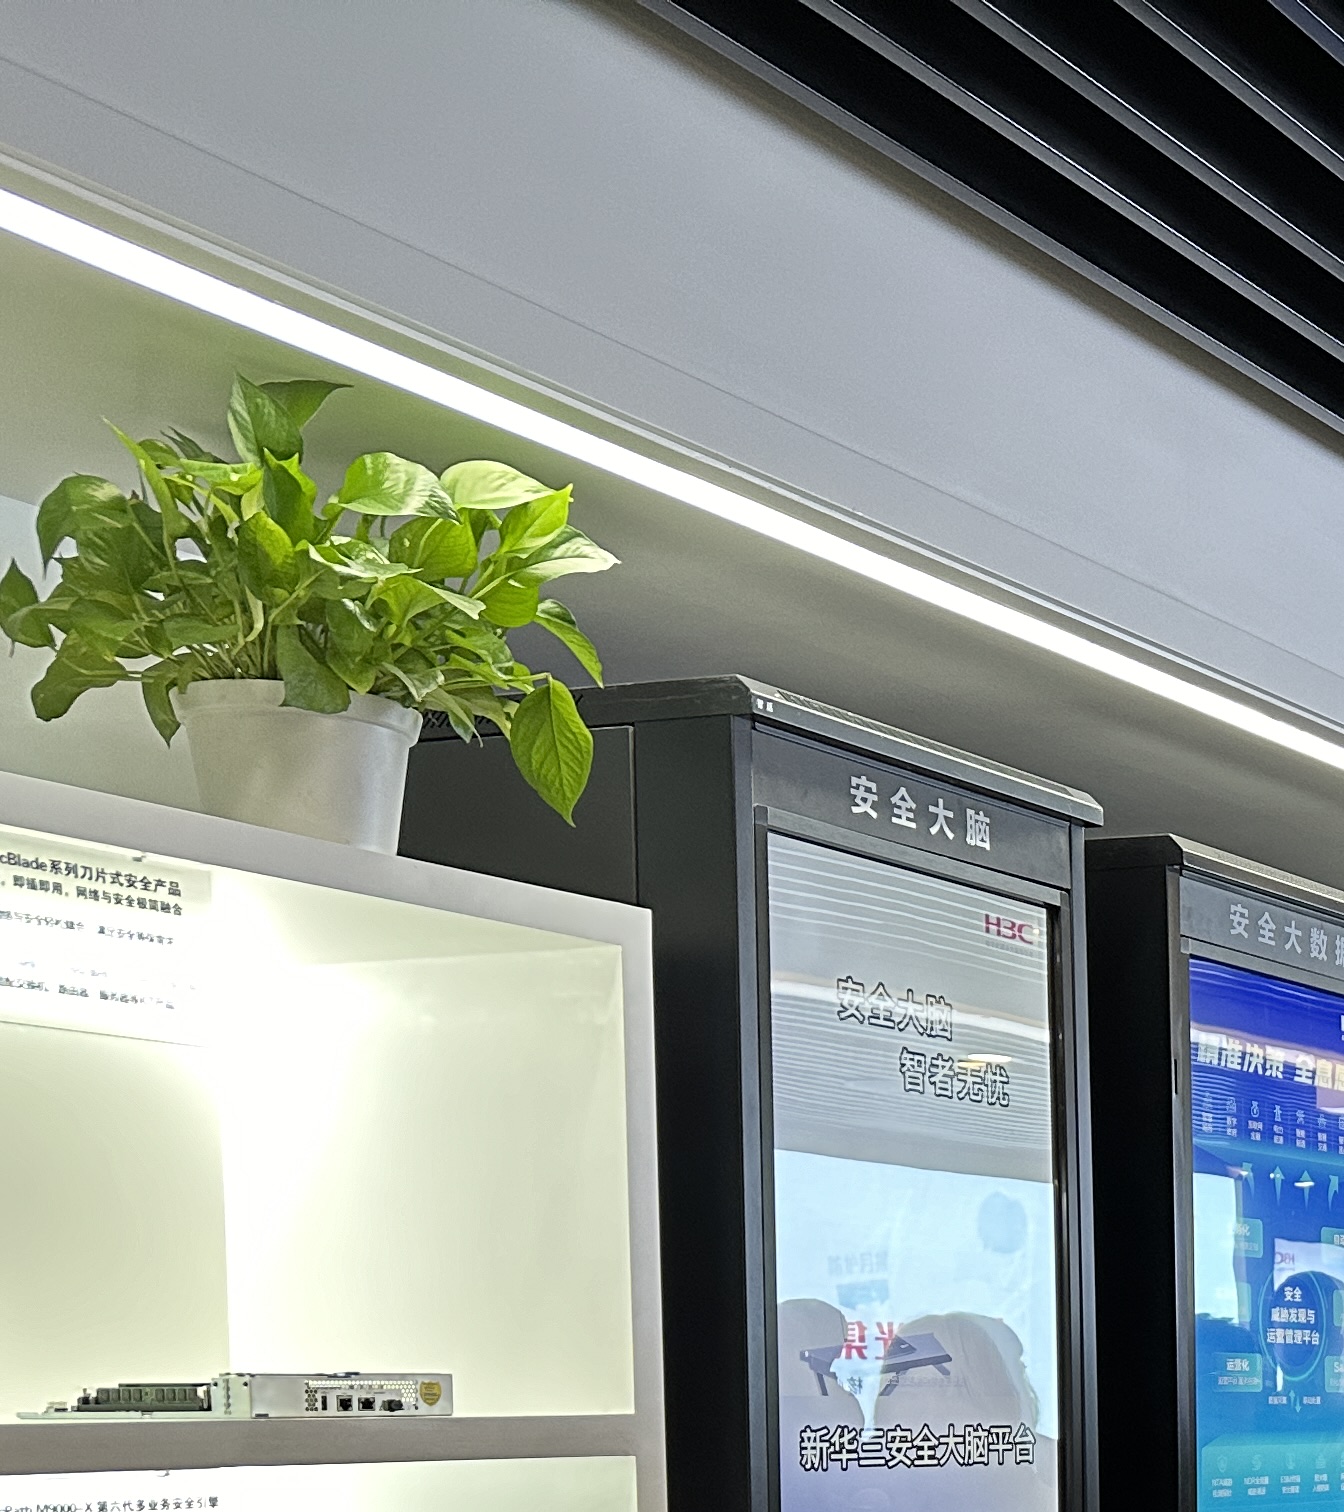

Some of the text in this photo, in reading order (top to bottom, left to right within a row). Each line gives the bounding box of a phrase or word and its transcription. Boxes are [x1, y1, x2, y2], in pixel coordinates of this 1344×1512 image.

[850, 775, 992, 851] 安全大脑
[984, 913, 1034, 945] H3C
[836, 977, 953, 1041] 安全大脑
[899, 1046, 1010, 1107] 智者无忧
[1284, 1287, 1302, 1302] 安全
[799, 1423, 1037, 1471] 新华三安全大脑平台
